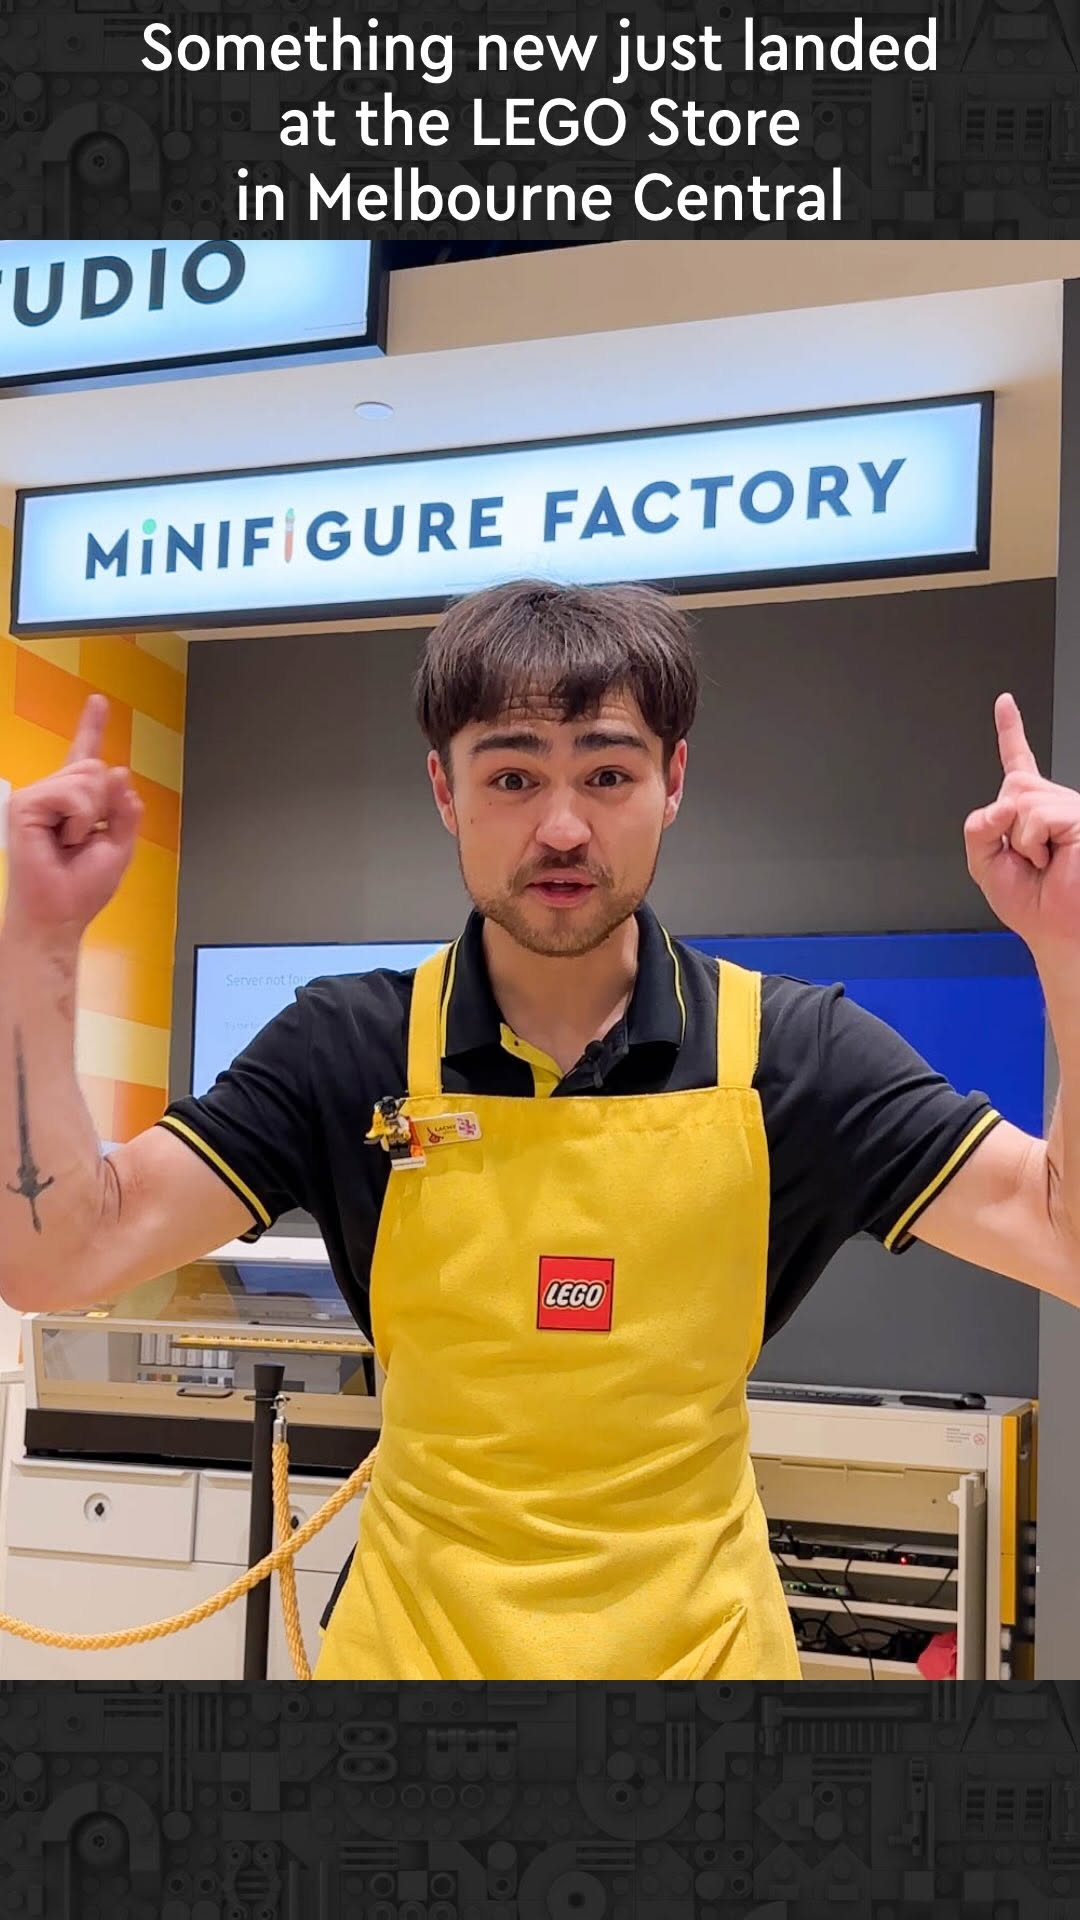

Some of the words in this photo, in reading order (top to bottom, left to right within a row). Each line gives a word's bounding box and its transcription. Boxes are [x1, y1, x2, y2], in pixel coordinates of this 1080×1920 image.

[0, 240, 246, 327] UDIO
[543, 458, 907, 542] FACTORY
[226, 973, 264, 987] Server
[266, 973, 285, 986] not
[544, 1281, 605, 1309] LEGO
